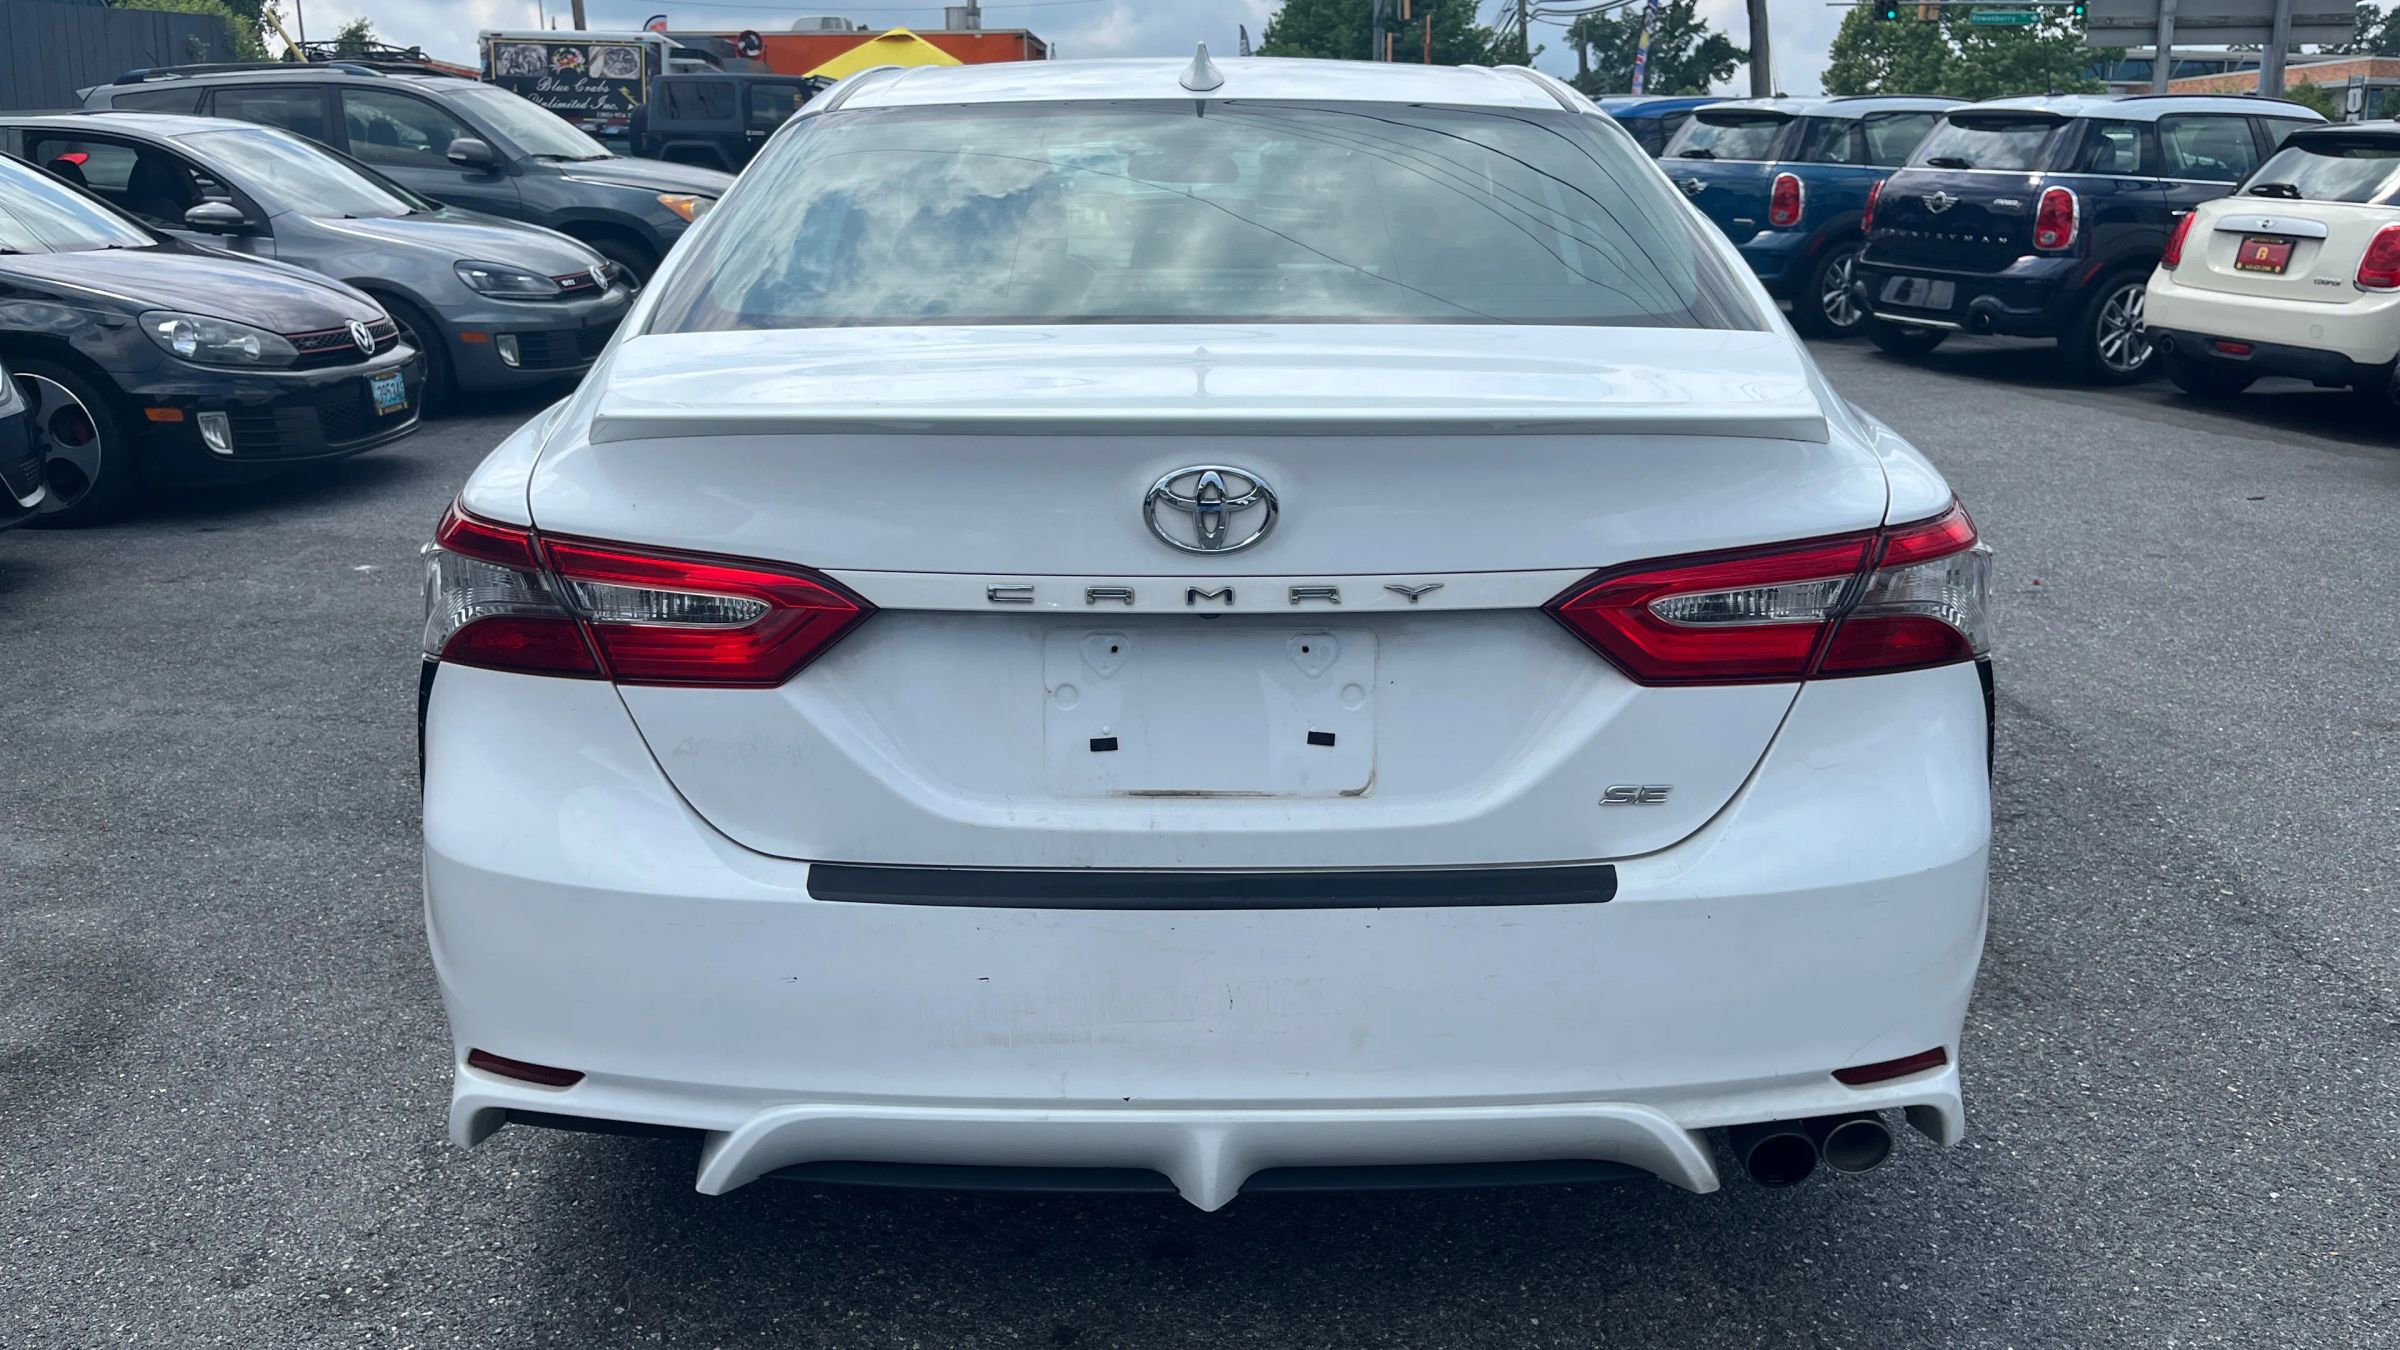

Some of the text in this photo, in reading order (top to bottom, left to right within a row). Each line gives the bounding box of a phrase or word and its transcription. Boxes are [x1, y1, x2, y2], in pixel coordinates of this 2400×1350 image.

[536, 76, 611, 93] Blue Crabs
[591, 95, 619, 110] Inc.
[985, 582, 1445, 606] CAMRY
[1599, 784, 1674, 806] SE
